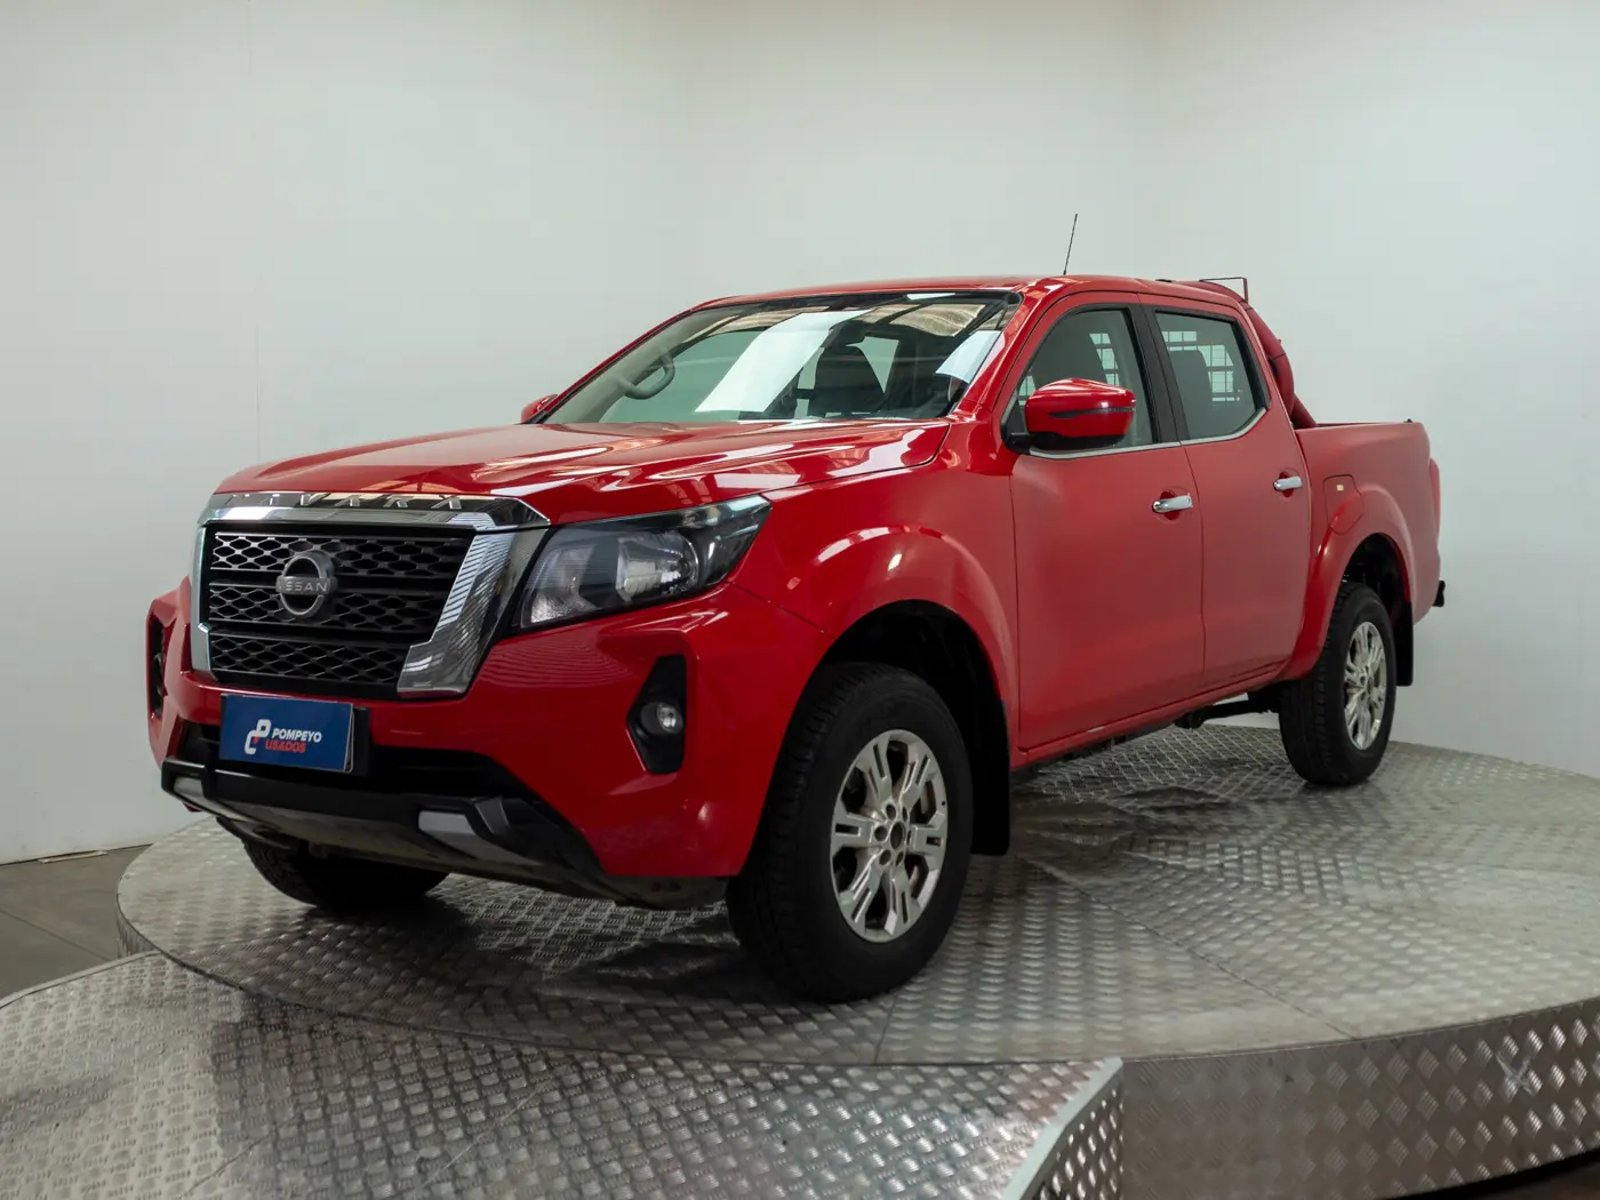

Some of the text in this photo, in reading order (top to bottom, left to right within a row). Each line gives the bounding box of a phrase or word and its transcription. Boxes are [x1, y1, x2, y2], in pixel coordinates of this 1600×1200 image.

[279, 581, 328, 592] SSAN
[271, 727, 323, 743] POMPEYO
[265, 739, 307, 753] USADOS
